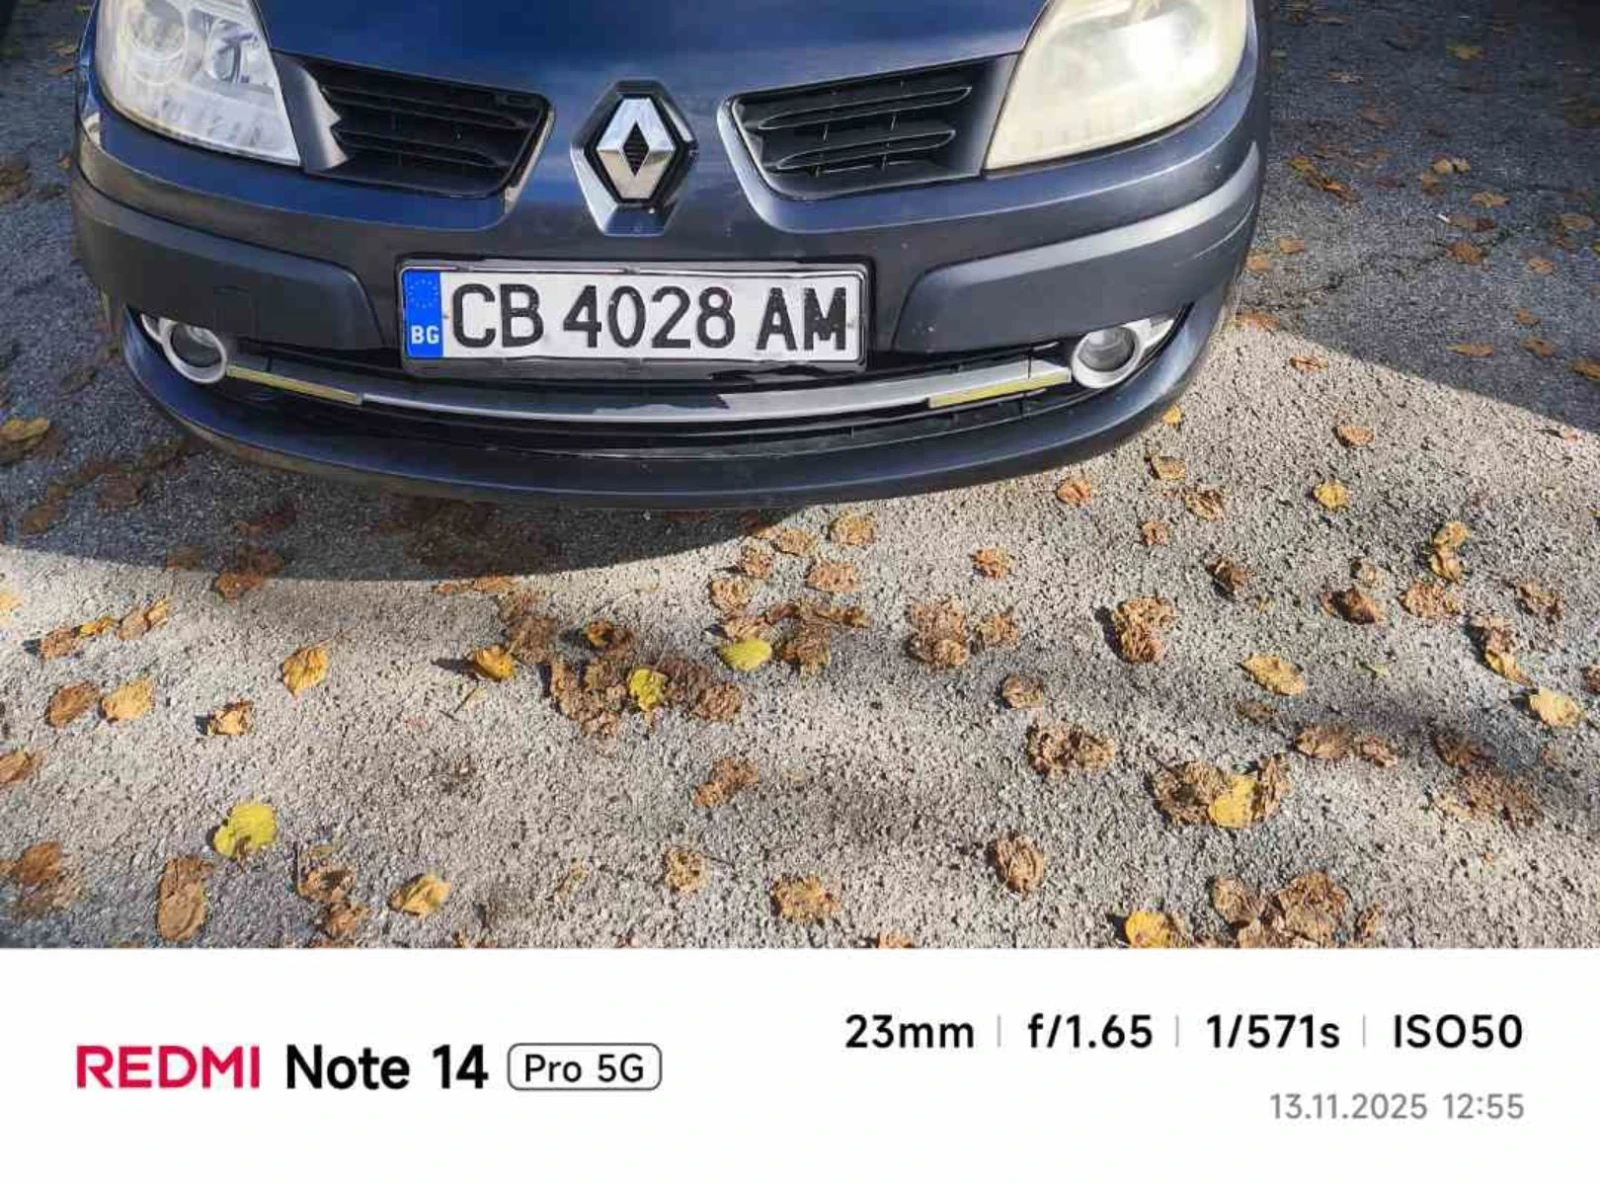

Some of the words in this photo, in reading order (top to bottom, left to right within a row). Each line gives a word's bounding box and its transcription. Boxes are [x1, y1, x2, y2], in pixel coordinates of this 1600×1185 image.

[411, 326, 439, 344] BG
[452, 283, 544, 348] CB
[562, 284, 736, 349] 4028
[756, 286, 847, 351] AM
